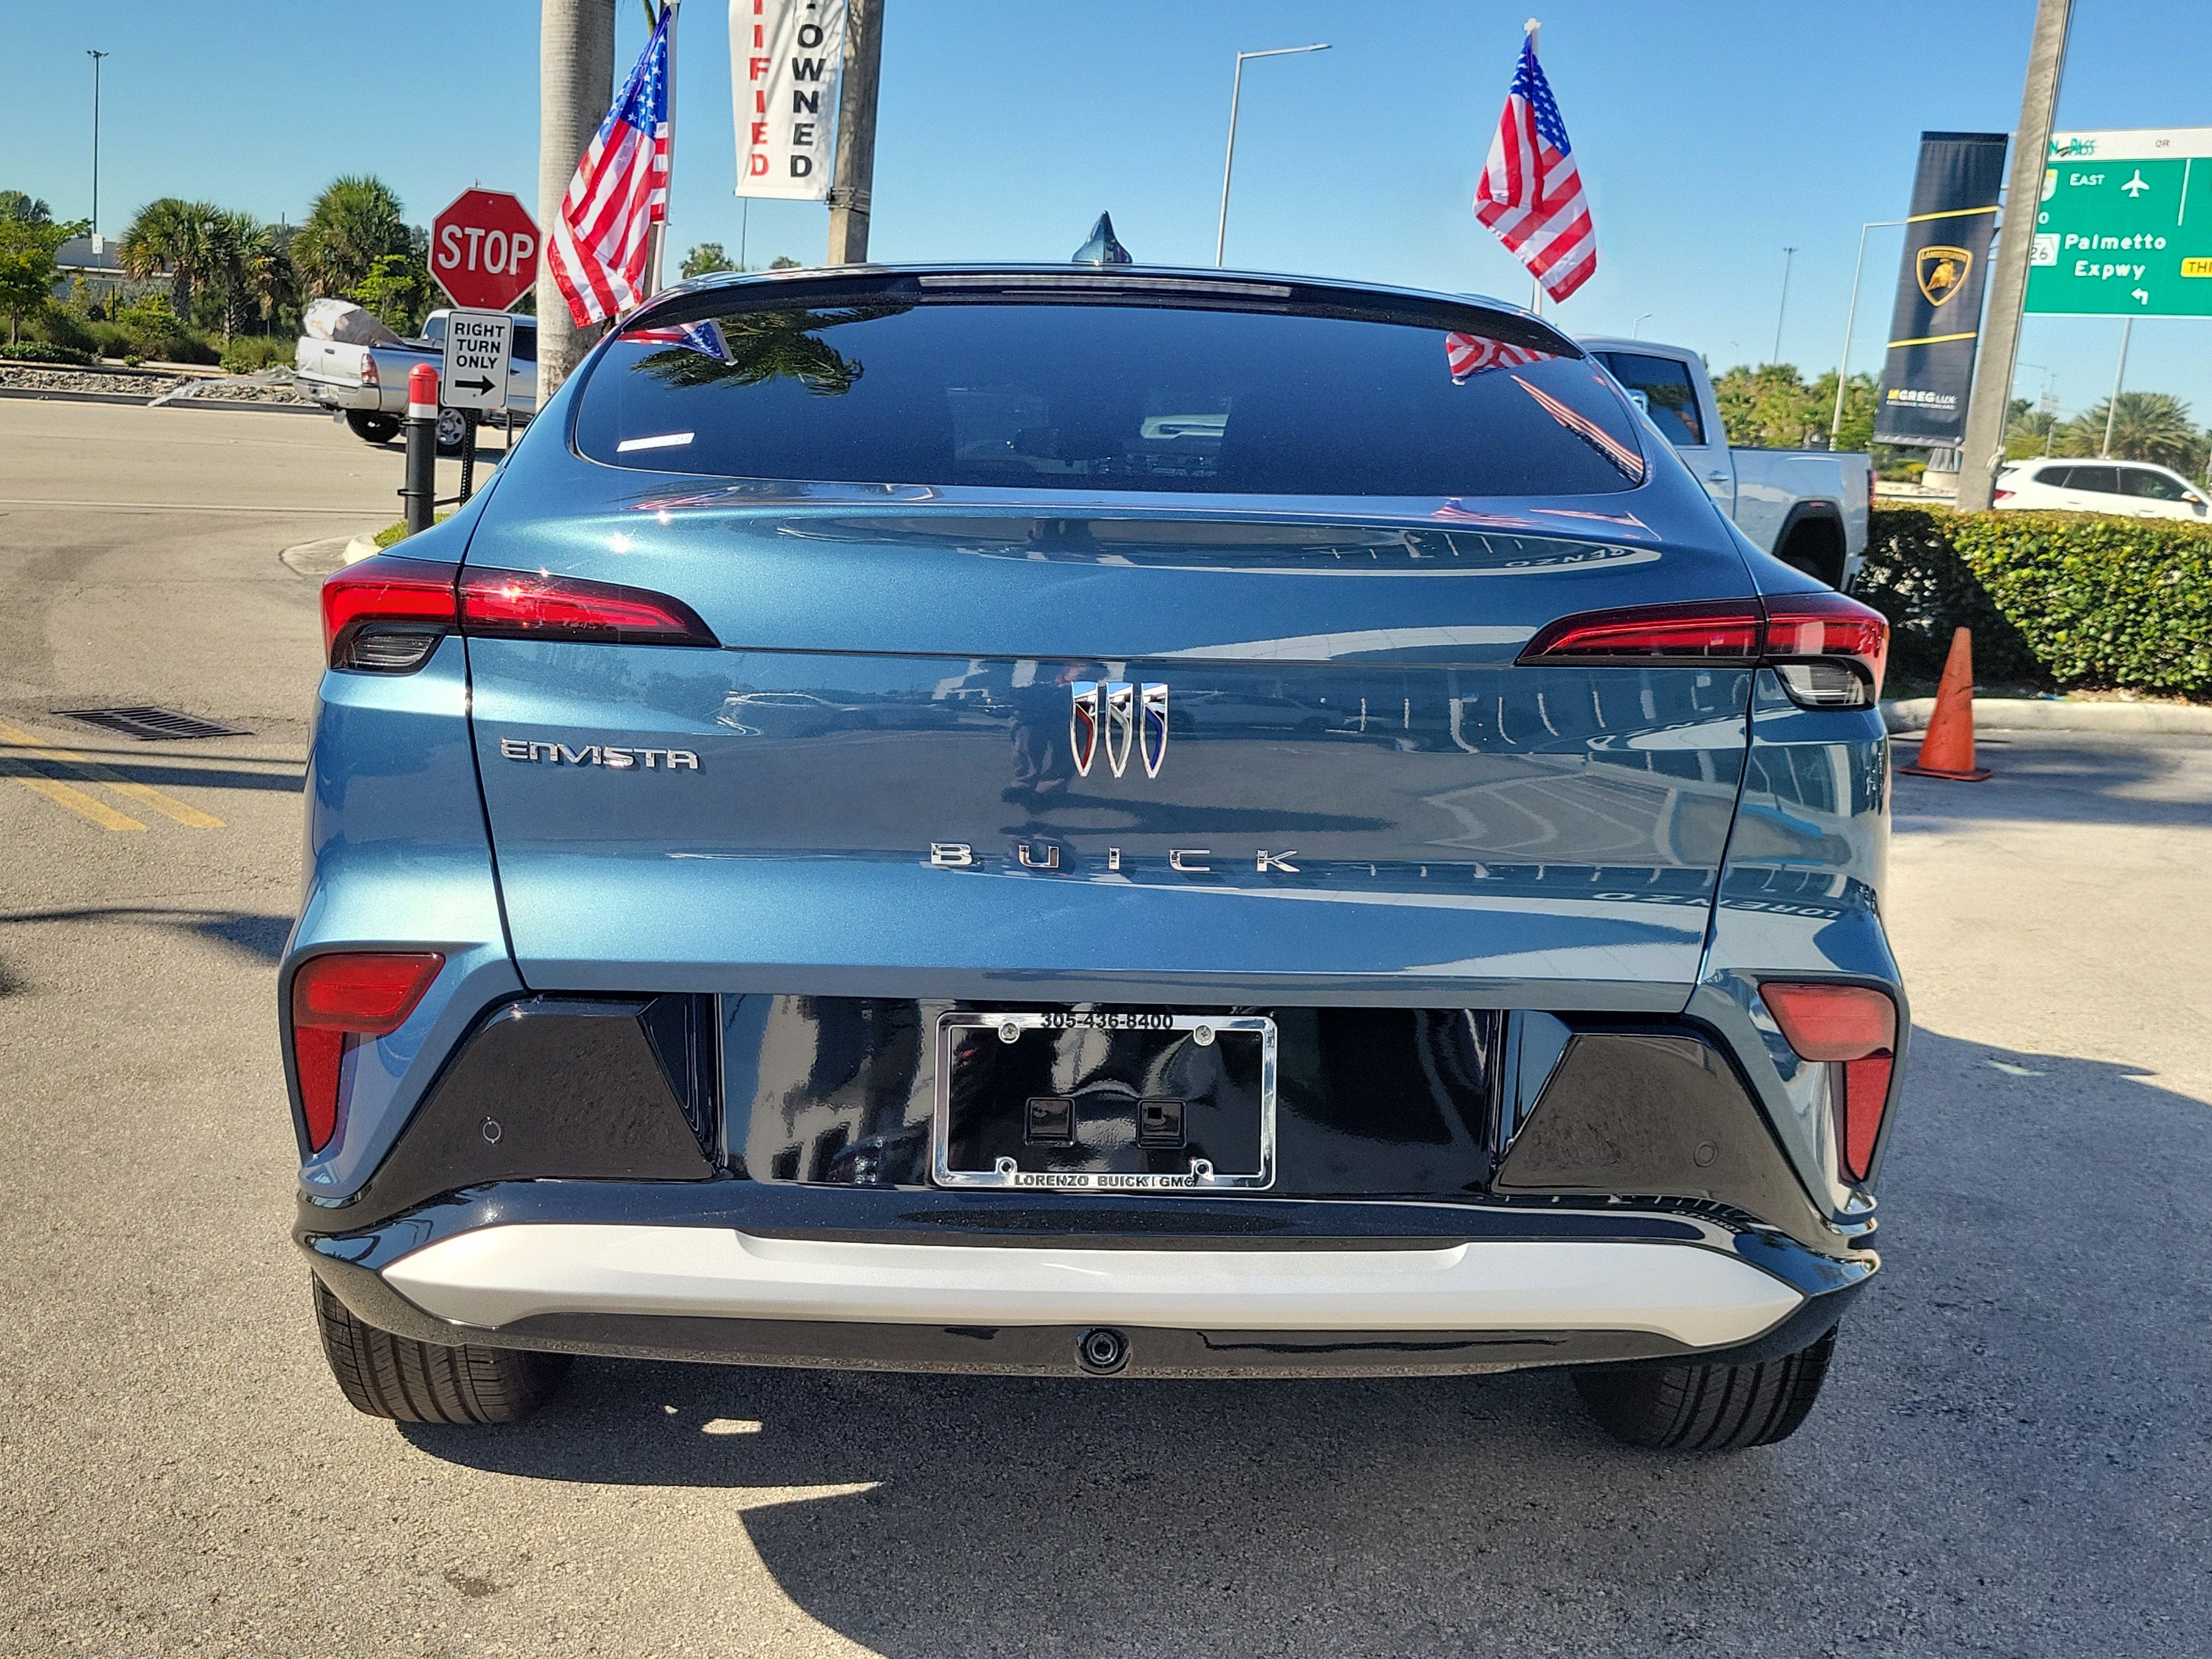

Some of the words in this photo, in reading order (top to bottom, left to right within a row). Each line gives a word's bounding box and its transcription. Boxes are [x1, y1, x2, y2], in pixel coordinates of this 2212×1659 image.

[2069, 173, 2106, 186] EAST
[438, 224, 534, 276] STOP
[2064, 233, 2166, 250] Palmetto
[2074, 259, 2146, 281] Expwy
[454, 322, 505, 338] RIGHT
[456, 338, 501, 354] TURN
[456, 355, 498, 370] ONLY
[500, 737, 699, 770] ENVISTA
[930, 842, 1300, 873] BUICK
[1041, 1012, 1174, 1029] 305-436-8400
[1014, 1174, 1090, 1187] LORENZO
[1097, 1175, 1149, 1187] BUICK
[1159, 1176, 1195, 1188] GMC
